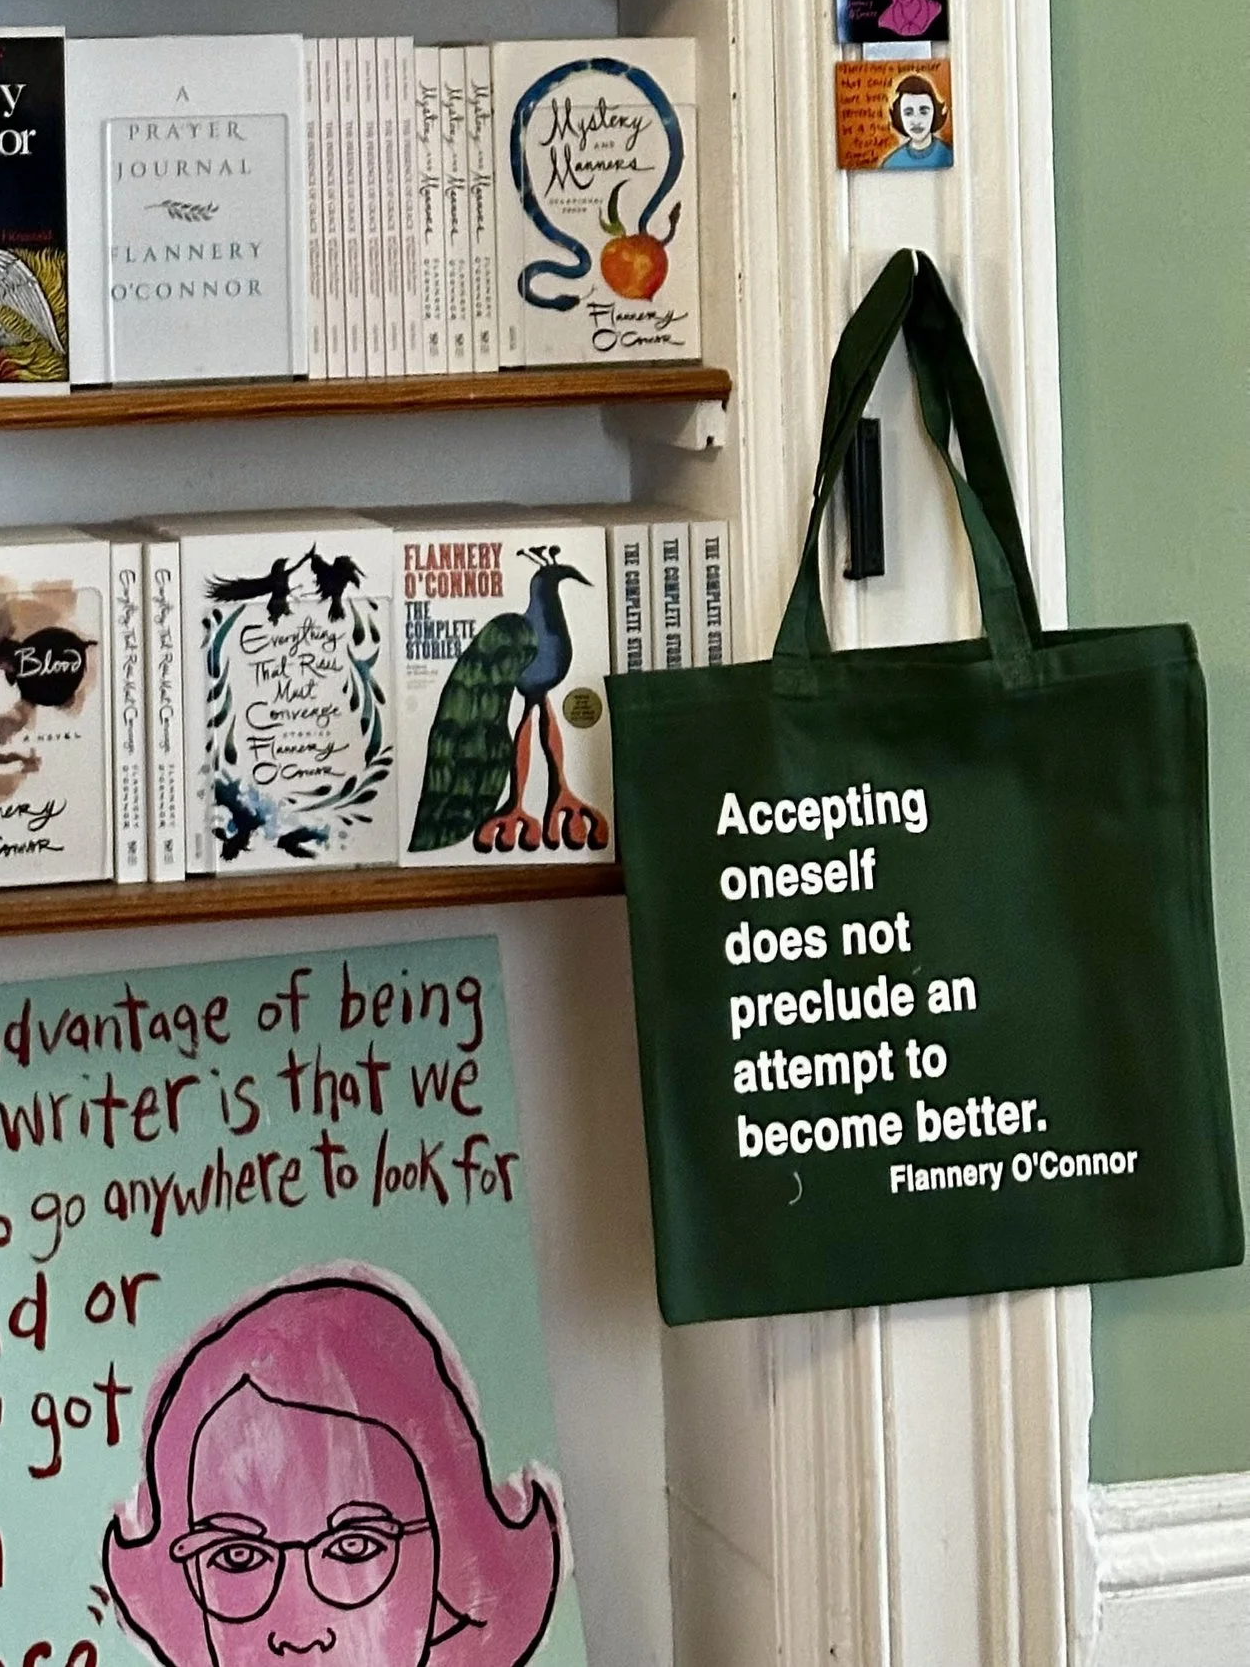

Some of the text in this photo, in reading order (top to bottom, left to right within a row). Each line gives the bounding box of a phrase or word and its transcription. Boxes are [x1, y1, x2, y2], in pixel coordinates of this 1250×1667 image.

[176, 85, 190, 103] A
[128, 120, 248, 142] PRAYER
[540, 96, 654, 152] Mystery
[117, 158, 253, 182] JOURNAL
[545, 144, 655, 199] Manners
[110, 241, 264, 265] FLANNERY
[110, 279, 264, 302] O'CONNOR
[587, 302, 689, 331] Flannery
[591, 328, 687, 352] O'Connor
[404, 542, 504, 571] FLANNERY
[624, 542, 640, 567] THE
[404, 571, 504, 599] O'CONNOR
[405, 601, 431, 620] THE
[624, 569, 642, 634] COMPLETE
[240, 617, 346, 657] Everything
[405, 619, 477, 640] COMPLETE
[14, 646, 83, 678] Blood
[405, 639, 463, 661] STORIES
[250, 653, 344, 686] That Rises
[246, 700, 342, 730] Converge
[246, 735, 350, 761] Flannery
[252, 761, 347, 785] O'Connor
[716, 782, 929, 840] Accepting
[719, 847, 876, 901] oneself
[724, 911, 911, 965] does not
[256, 968, 314, 1032] of
[339, 960, 483, 1052] being
[730, 974, 977, 1040] preclude an
[733, 1038, 947, 1095] attempt to
[212, 1068, 261, 1136] is
[277, 1040, 392, 1119] that
[410, 1055, 483, 1117] we
[737, 1095, 1048, 1158] become better.
[889, 1147, 1138, 1194] Flannery O'Connor
[30, 1193, 86, 1263] go
[104, 1148, 308, 1238] anywhere
[313, 1129, 358, 1199] to
[372, 1129, 450, 1208] look
[452, 1133, 520, 1206] for
[84, 1269, 161, 1328] or
[28, 1360, 133, 1480] got
